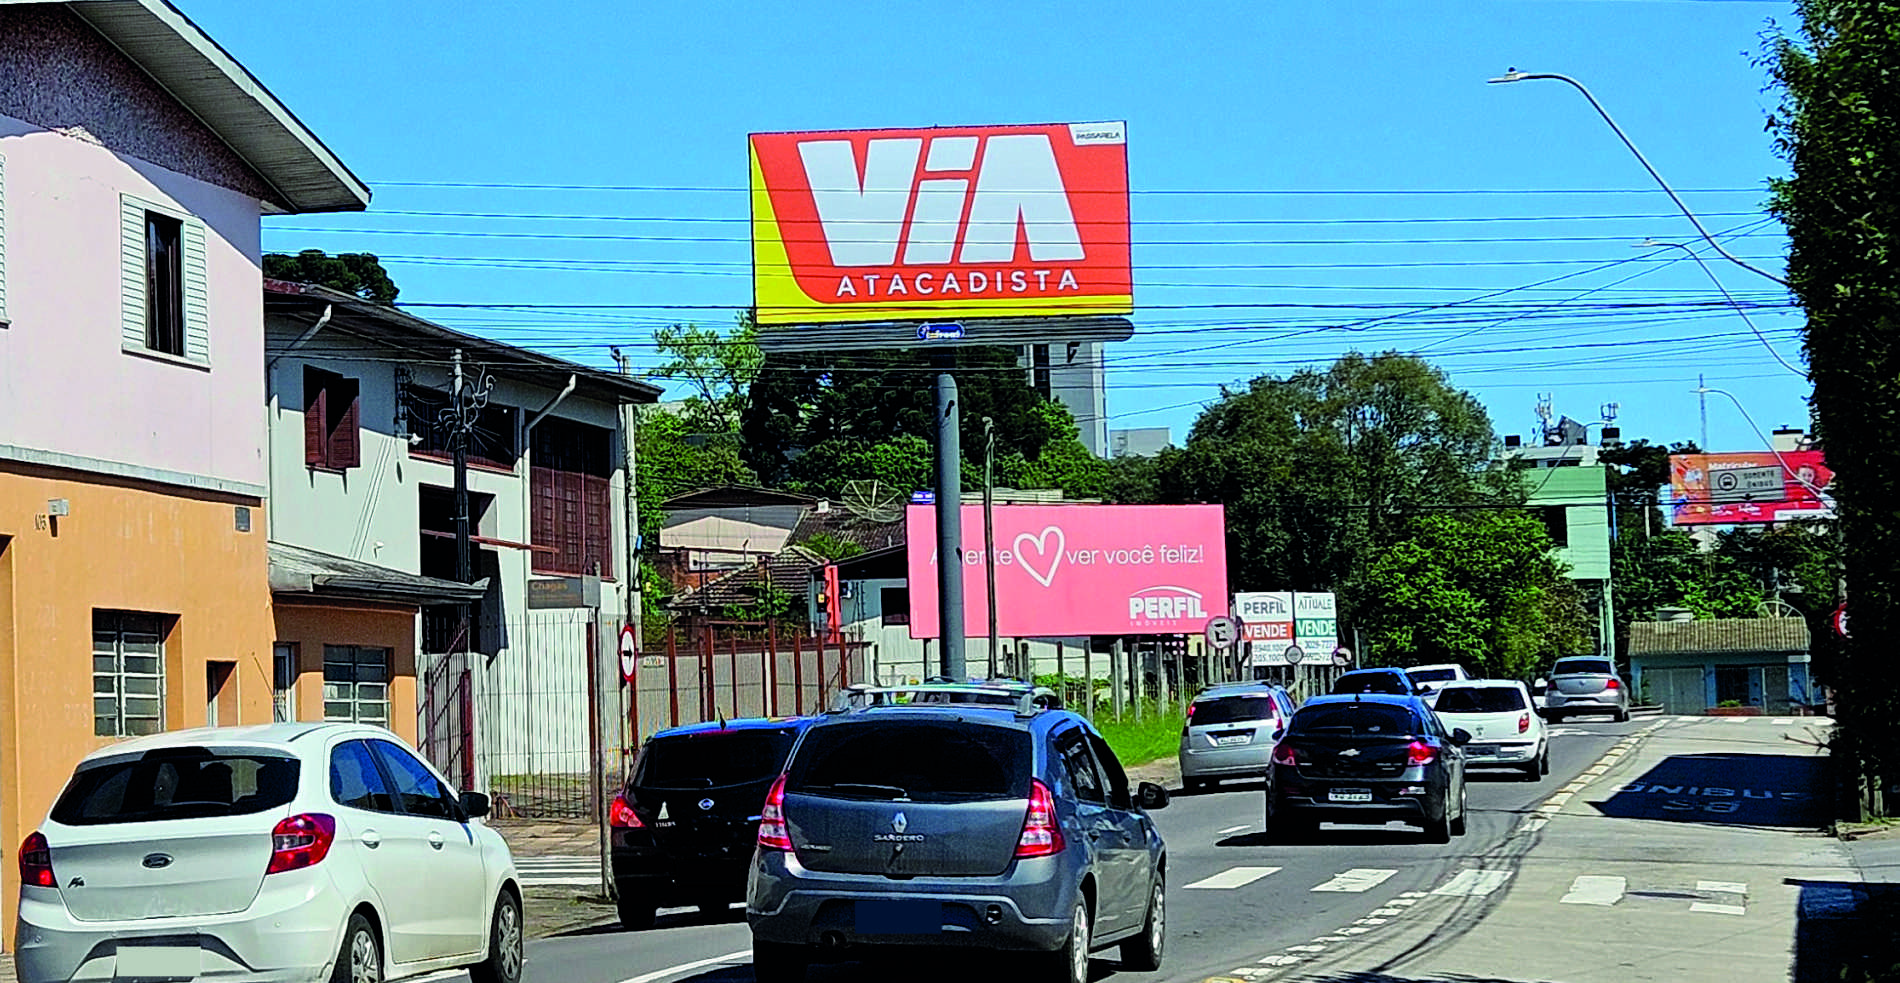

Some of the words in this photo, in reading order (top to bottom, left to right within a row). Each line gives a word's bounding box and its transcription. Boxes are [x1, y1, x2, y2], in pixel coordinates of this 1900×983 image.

[836, 269, 1080, 297] ATACADISTA
[1066, 550, 1099, 565] ver
[1104, 544, 1154, 565] você
[1159, 544, 1204, 564] feliz!
[1129, 596, 1208, 619] PERFIL
[1243, 601, 1287, 615] PERFIL
[1244, 624, 1288, 638] VENDE
[1296, 620, 1337, 636] VENDE
